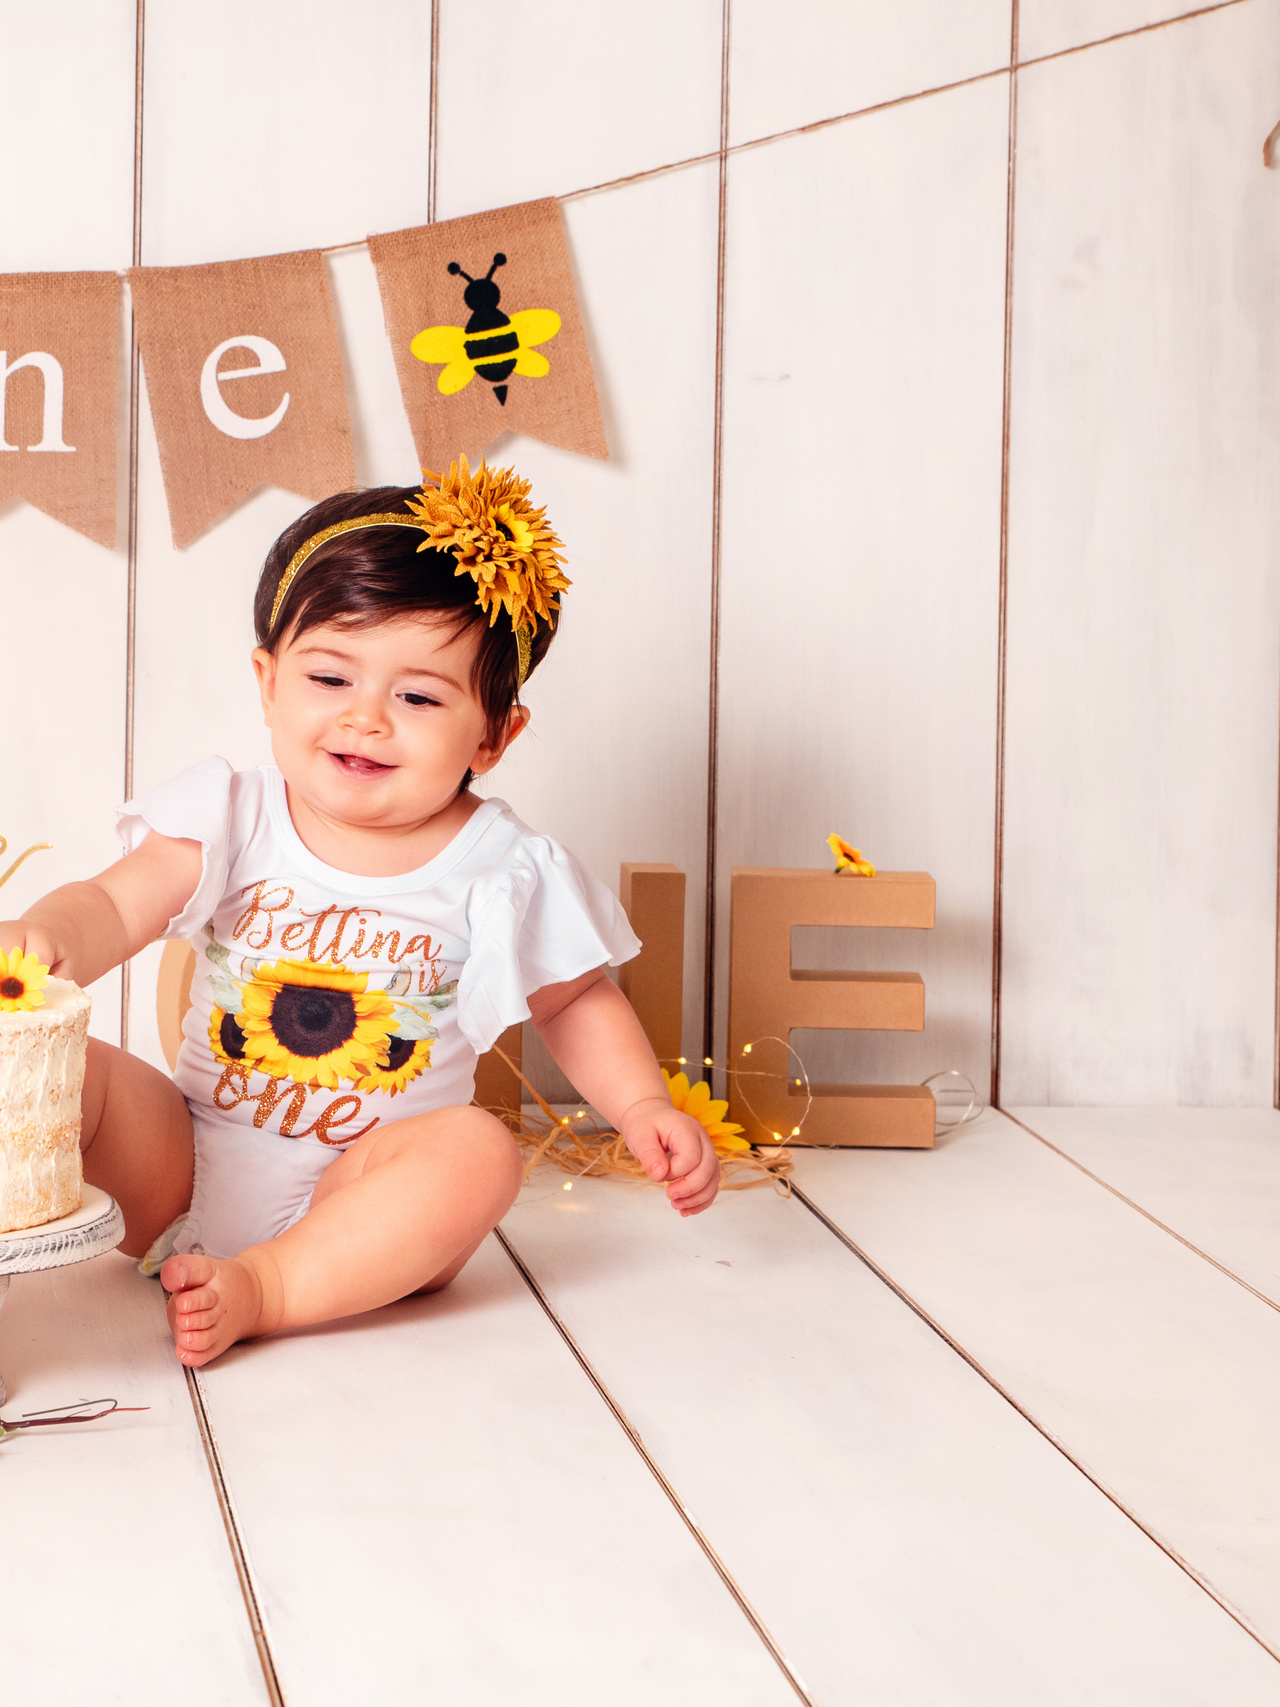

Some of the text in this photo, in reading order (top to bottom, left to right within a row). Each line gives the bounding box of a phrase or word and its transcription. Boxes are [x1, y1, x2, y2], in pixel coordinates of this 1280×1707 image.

[231, 879, 442, 965] Bettina
[417, 957, 448, 994] is
[212, 1060, 381, 1146] one
